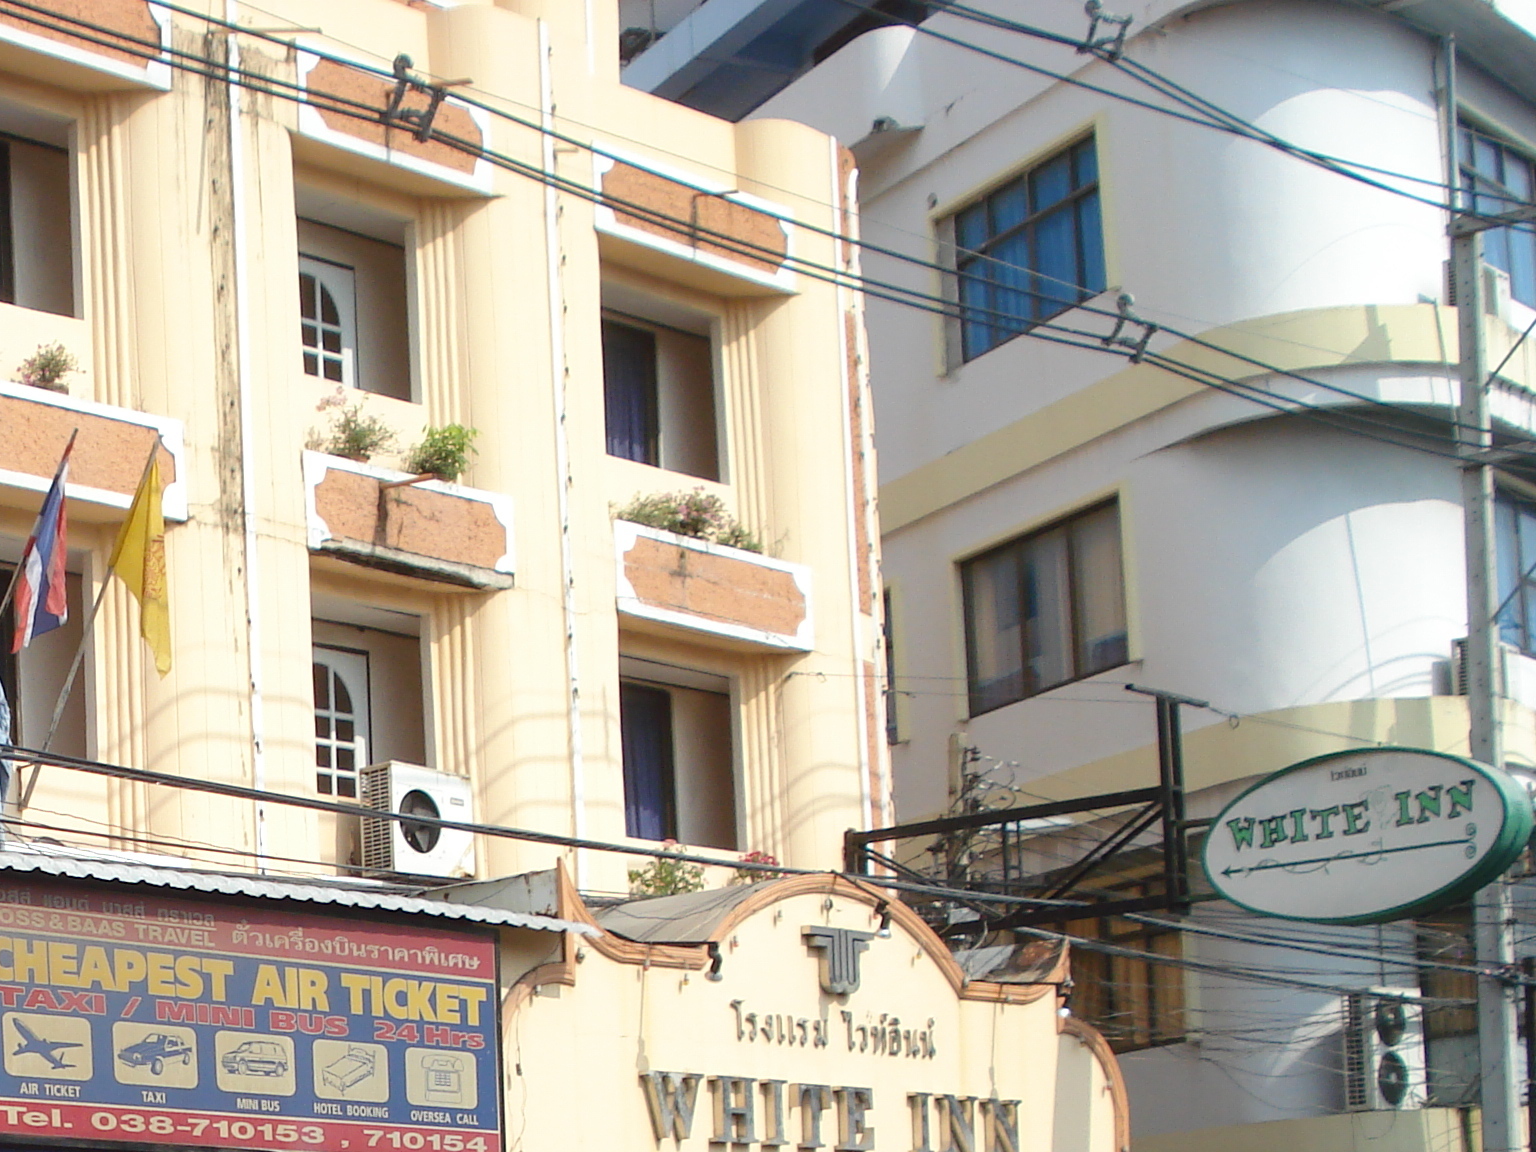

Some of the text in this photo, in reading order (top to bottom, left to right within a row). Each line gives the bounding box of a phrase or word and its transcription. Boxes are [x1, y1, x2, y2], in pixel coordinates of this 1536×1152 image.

[1226, 779, 1476, 852] WHITE INN
[134, 923, 216, 947] TRAVEL
[251, 963, 330, 1012] AIR
[340, 973, 487, 1026] TICKET
[120, 996, 141, 1019] /
[155, 1000, 256, 1030] MINI
[270, 1009, 350, 1037] BUS
[729, 999, 828, 1050] โรงแรม
[20, 1083, 81, 1098] AIR TICKET
[141, 1090, 167, 1105] TAXI
[237, 1097, 281, 1113] MINI BUS
[313, 1102, 389, 1119] HOTEL BOOKING
[90, 1112, 326, 1144] 038-710153
[410, 1109, 479, 1126] OVERSEA CALL
